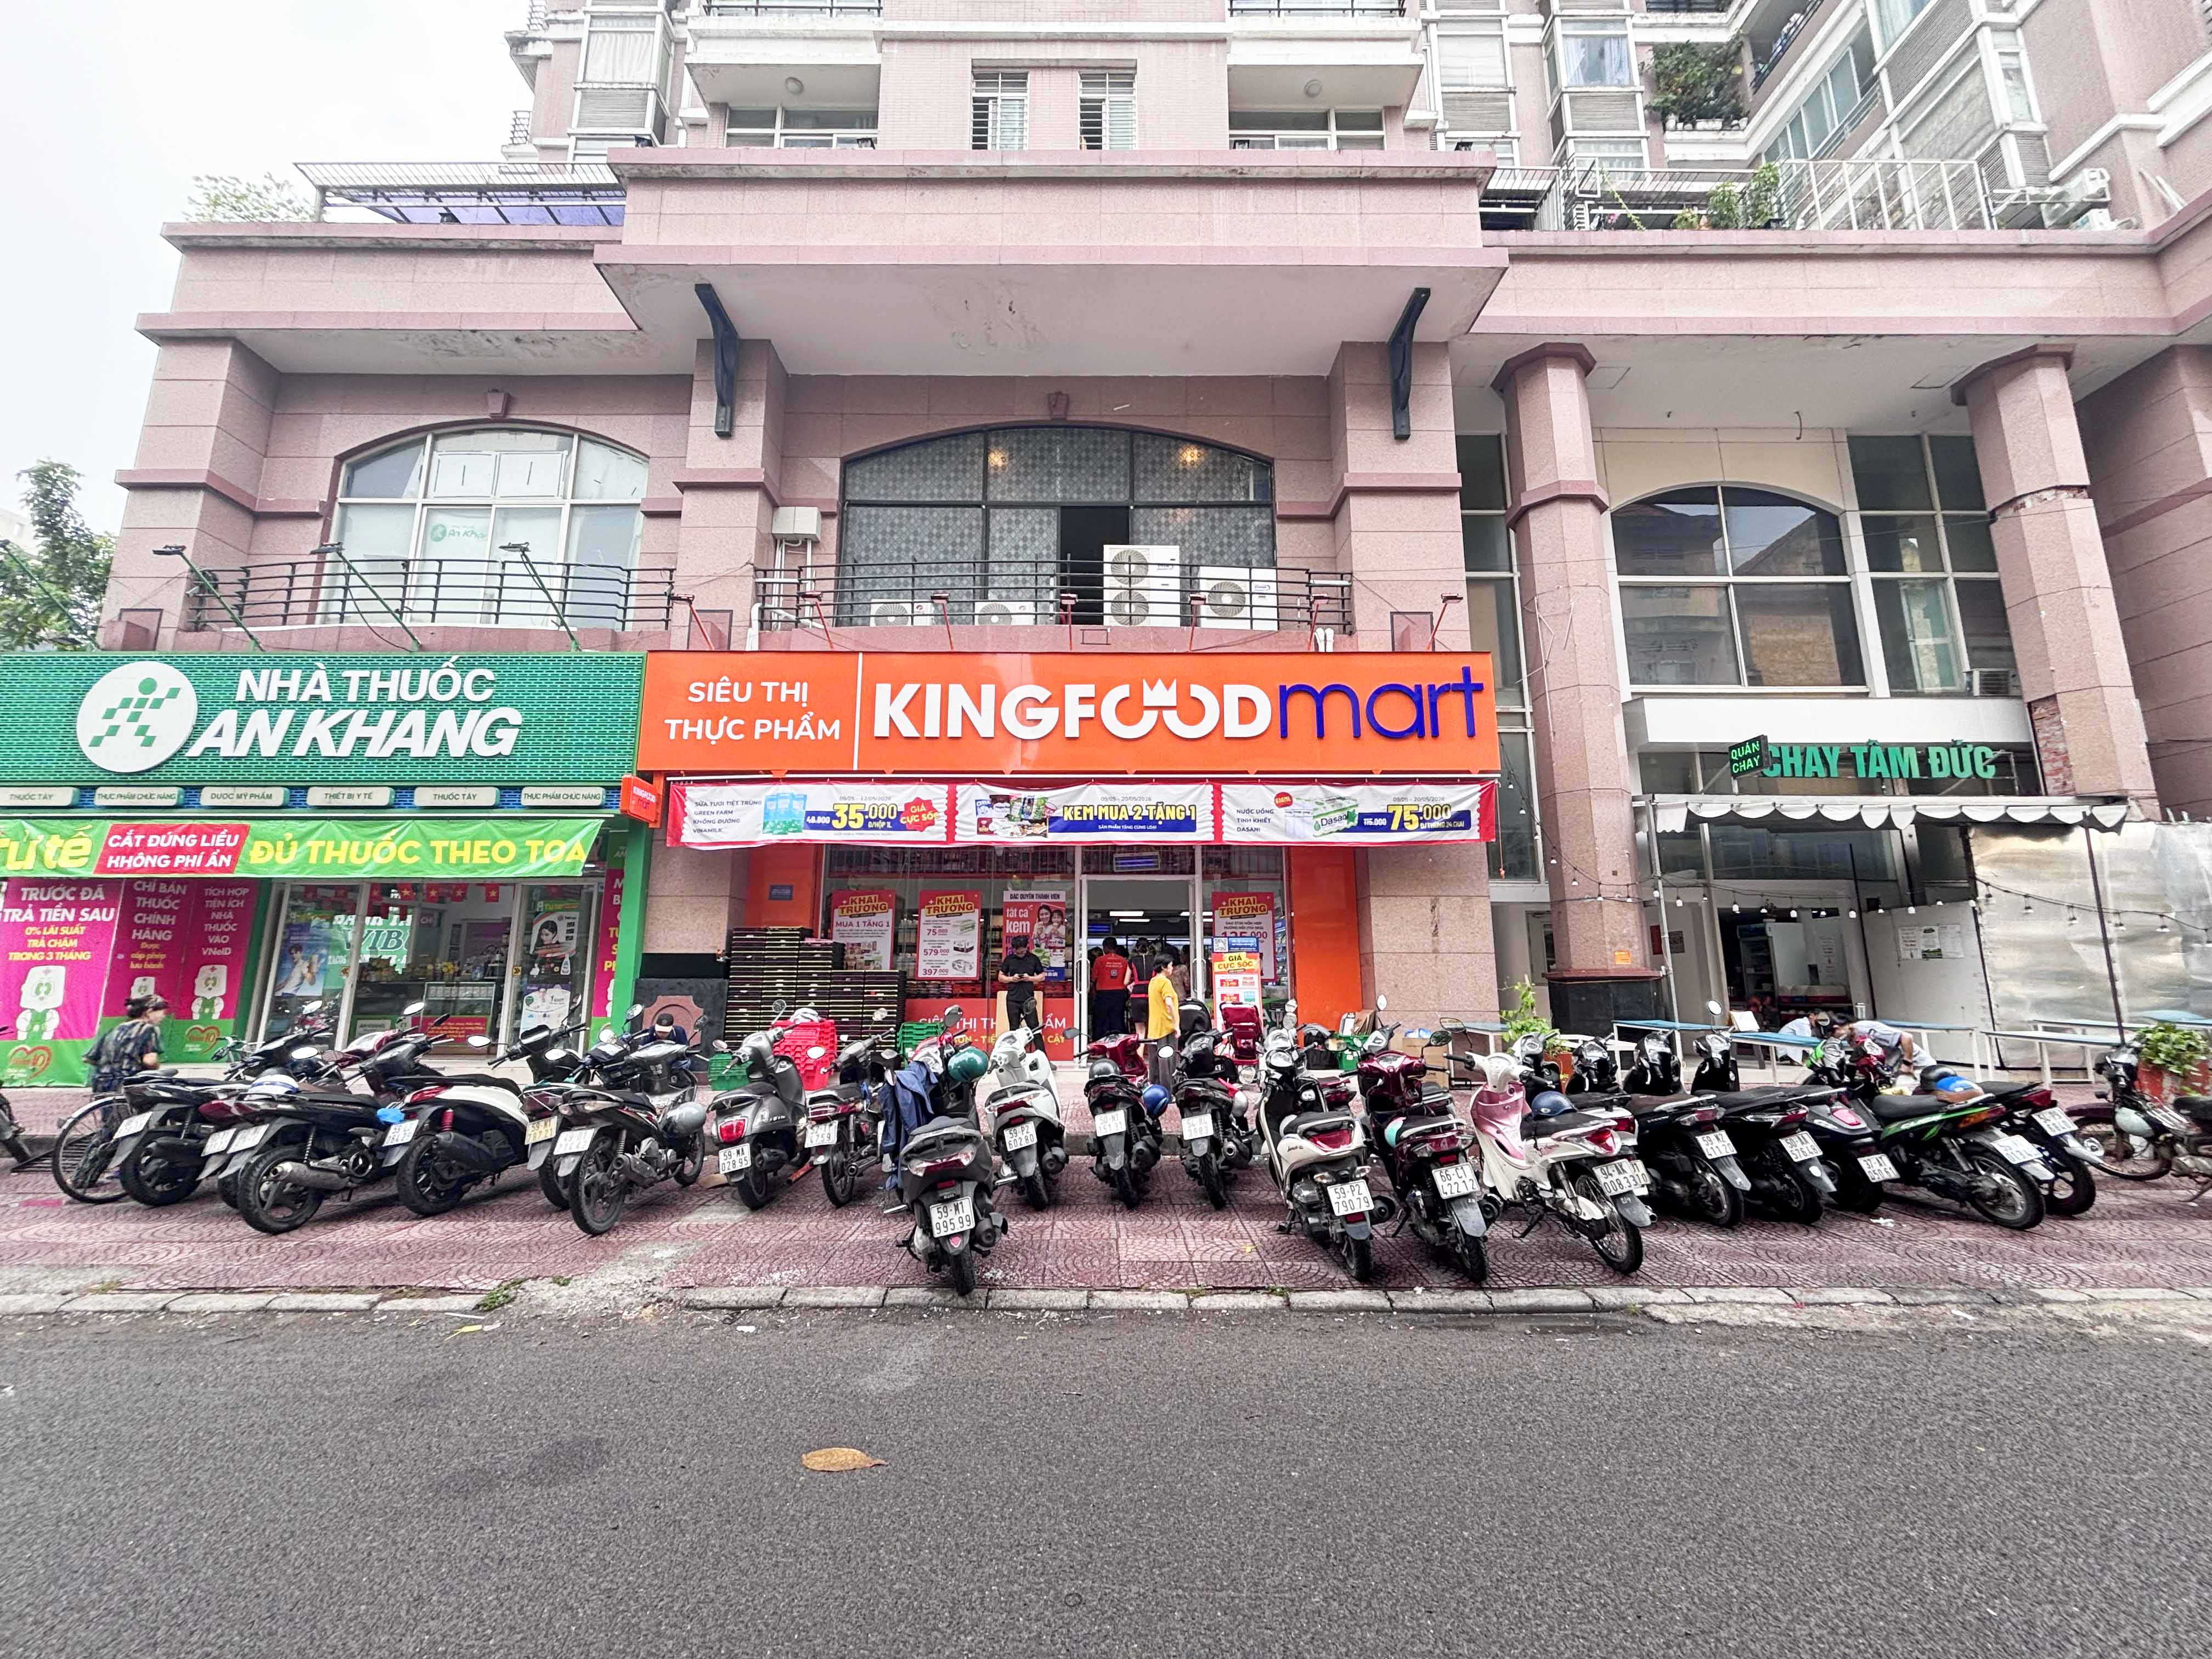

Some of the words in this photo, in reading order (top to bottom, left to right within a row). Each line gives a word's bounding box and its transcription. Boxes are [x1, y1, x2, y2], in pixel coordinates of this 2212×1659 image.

[235, 662, 332, 702] NHÀ
[341, 655, 495, 702] THUỐC
[687, 675, 752, 703] SIÊU
[760, 681, 808, 708] THỊ
[184, 709, 295, 757] AN
[291, 707, 523, 758] KHANG
[664, 715, 745, 746] THỰC
[754, 710, 840, 741] PHẨM
[1731, 741, 1760, 760] QUÁN
[1763, 744, 1840, 778] CHAY
[1850, 738, 1919, 778] TÂM
[1927, 738, 1996, 778] ĐỨC
[1733, 755, 1760, 774] CHAY
[910, 803, 927, 812] GIÁ
[1063, 804, 1094, 821] KEM
[1097, 804, 1130, 821] MUA
[1132, 804, 1143, 821] 2
[1146, 802, 1187, 825] TẶNG
[1188, 804, 1197, 821] 1
[1256, 806, 1274, 814] UỐNG
[832, 803, 898, 829] 35.000
[900, 814, 920, 826] CỰC
[1387, 804, 1452, 831] 75.000
[109, 831, 143, 848] CẮT
[146, 831, 198, 848] ĐÚNG
[200, 828, 240, 848] LIỀU
[249, 832, 299, 864] ĐỦ
[307, 827, 420, 865] THUỐC
[430, 840, 516, 865] THEO
[529, 839, 588, 864] TOA
[106, 852, 171, 868] KHÔNG
[173, 852, 204, 868] PHÍ
[205, 850, 232, 868] ẨN
[21, 883, 77, 901] TRƯỚC
[159, 882, 188, 895] BÁN
[204, 887, 225, 896] TÍCH
[136, 894, 180, 910] THUỐC
[850, 895, 877, 905] KHAI
[926, 903, 973, 913] TRƯƠNG
[936, 896, 963, 905] KHAI
[1229, 897, 1256, 906] KHAI
[3, 904, 35, 922] TRẢ
[40, 902, 76, 922] TIỀN
[78, 907, 116, 922] SAU
[838, 903, 887, 915] TRƯƠNG
[1219, 905, 1267, 916] TRƯƠNG
[133, 911, 177, 925] CHÍNH
[862, 919, 884, 929] TẶNG
[1006, 919, 1030, 933] kem
[25, 926, 42, 935] 0%
[8, 951, 46, 961] TRONG
[46, 951, 54, 961] 3
[54, 950, 92, 961] THÁNG
[1217, 963, 1237, 971] CỰC
[956, 1017, 977, 1032] THỊ
[980, 1017, 997, 1029] TH
[1044, 1013, 1066, 1028] ẨM
[1009, 1125, 1030, 1139] 59-P2
[1439, 1166, 1469, 1182] 66-C1
[1334, 1183, 1363, 1200] 59-P2
